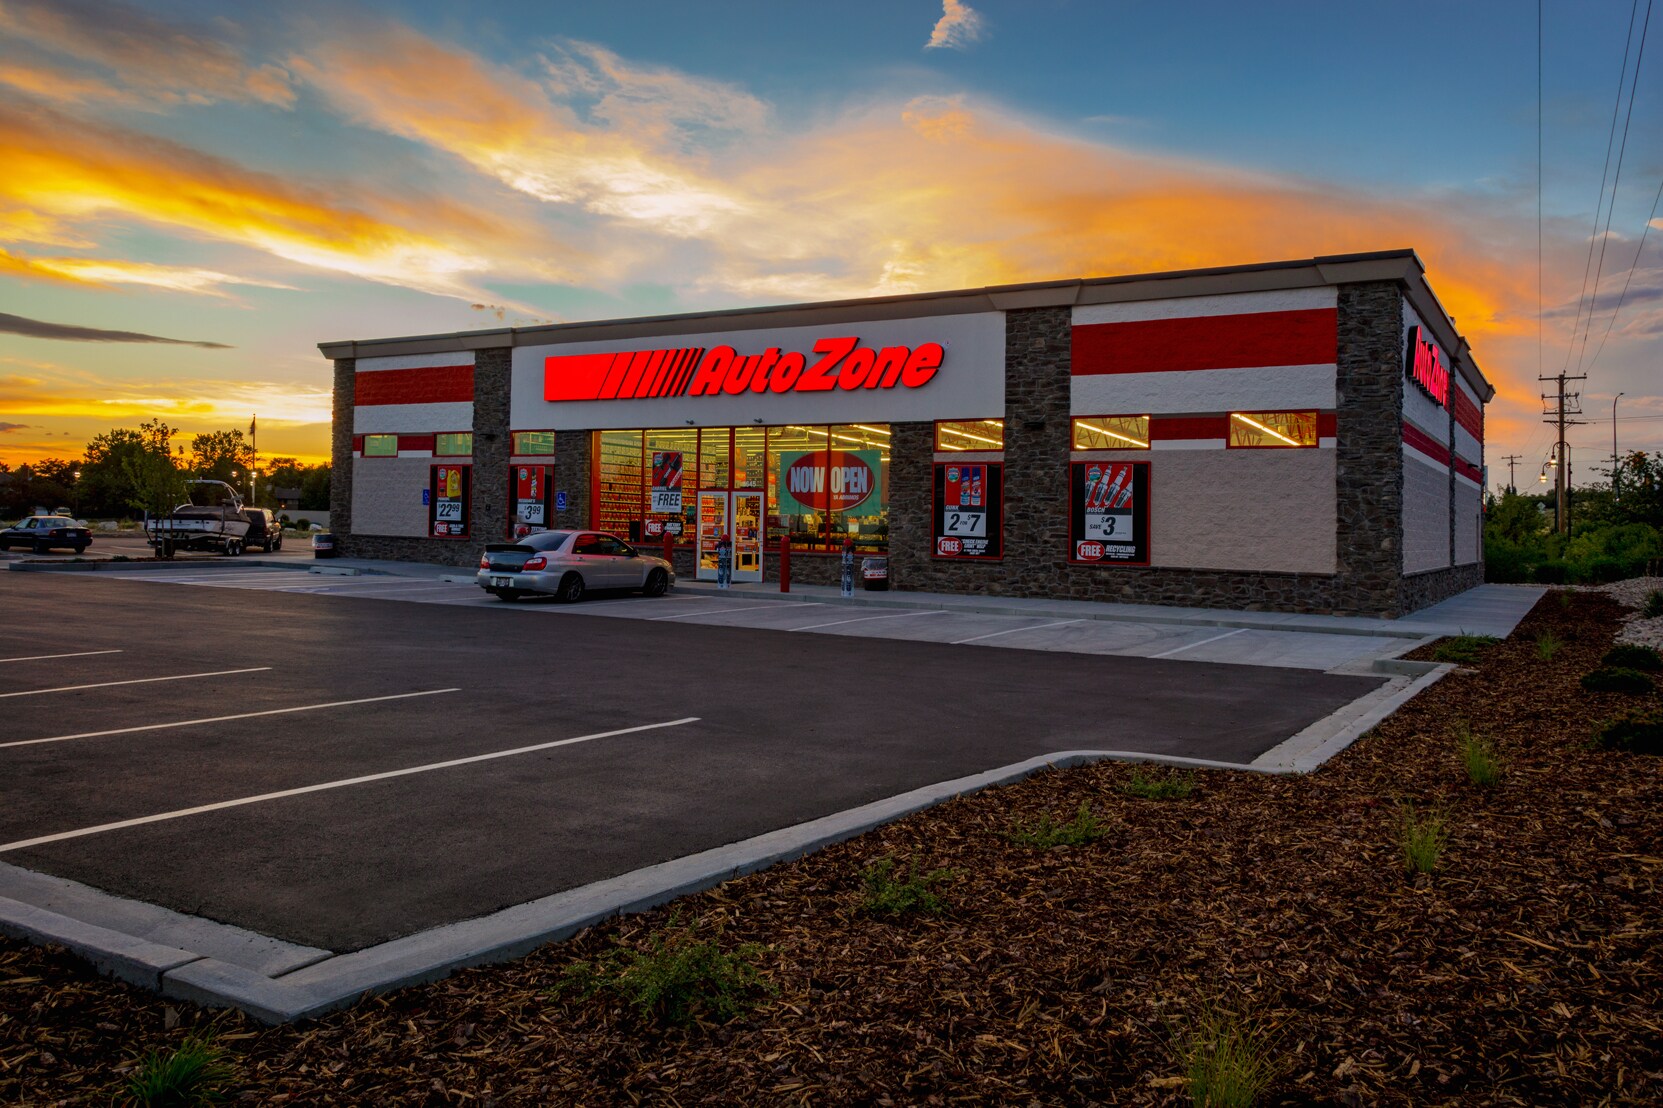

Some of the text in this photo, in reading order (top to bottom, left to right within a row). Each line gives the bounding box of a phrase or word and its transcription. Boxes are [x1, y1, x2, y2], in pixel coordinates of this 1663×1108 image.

[687, 336, 945, 396] AutoZone
[790, 466, 868, 494] NOW OPEN
[658, 493, 681, 506] FREE
[436, 523, 448, 533] FREE
[647, 523, 662, 533] FREE
[948, 513, 960, 531] 2
[967, 514, 981, 532] $7
[1100, 516, 1117, 536] $3
[941, 540, 959, 552] FREE
[1080, 544, 1101, 557] FREE
[1105, 544, 1136, 553] RECYCLING
